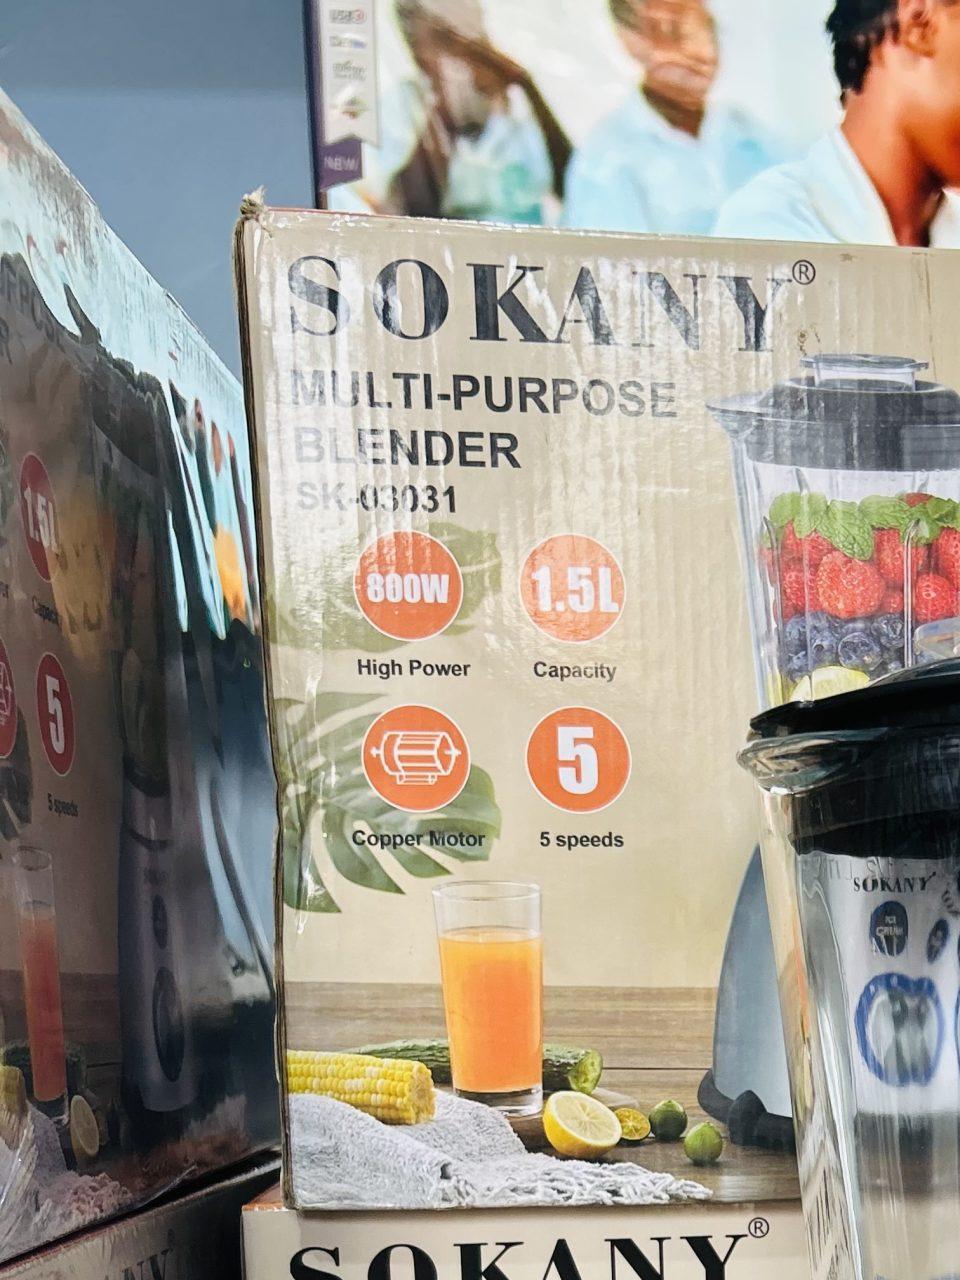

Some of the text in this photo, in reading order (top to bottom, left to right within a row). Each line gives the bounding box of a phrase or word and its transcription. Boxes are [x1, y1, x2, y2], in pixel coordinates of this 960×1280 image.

[290, 370, 678, 418] MULTI-PURPOSE
[295, 428, 522, 469] BLENDER
[296, 483, 457, 514] SK-03031
[366, 572, 449, 604] 800W
[531, 565, 620, 613] 1.5L
[357, 659, 471, 680] High Power
[533, 661, 617, 682] Capacity
[46, 674, 65, 754] 5
[557, 726, 599, 795] 5
[352, 829, 485, 852] Copper Motor
[540, 831, 624, 852] 5 speeds
